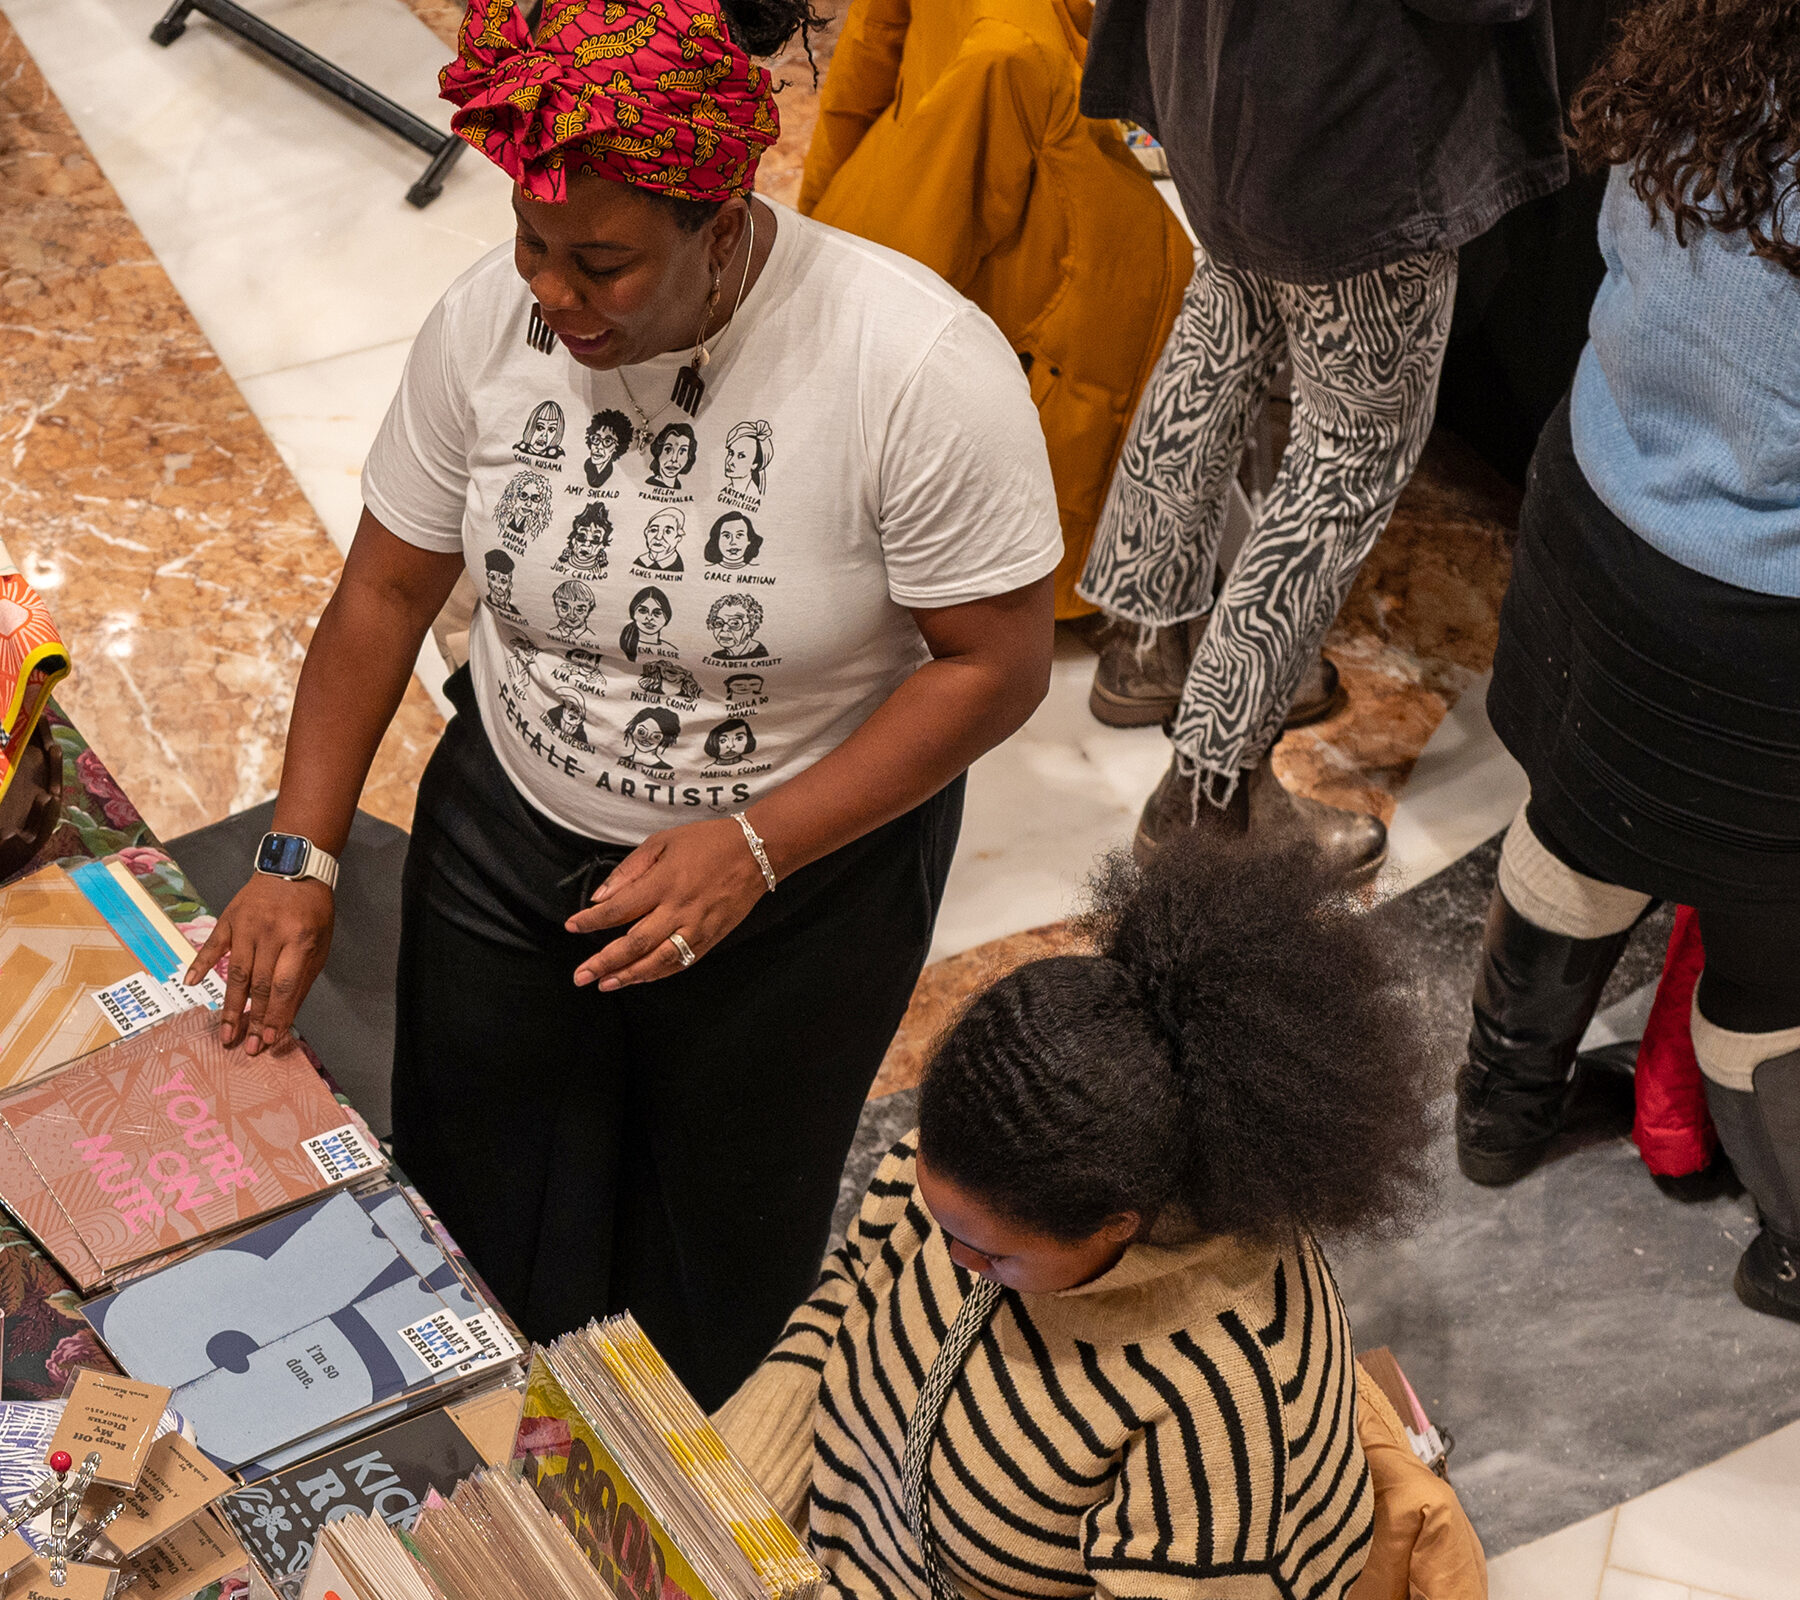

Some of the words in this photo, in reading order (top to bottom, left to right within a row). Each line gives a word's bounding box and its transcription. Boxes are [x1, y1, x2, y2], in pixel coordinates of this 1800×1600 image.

[534, 459, 563, 472] KUSAMA
[564, 484, 584, 496] AMY
[587, 487, 620, 500] SHERALD
[652, 487, 675, 496] HELEN
[502, 540, 525, 558] KRUGER
[550, 562, 568, 575] JUDY
[572, 569, 609, 580] CHICAGO
[629, 568, 652, 579] AGNES
[654, 572, 684, 582] MARTIN
[704, 571, 731, 583] GRACE
[737, 573, 777, 585] HARTIGAN
[637, 647, 654, 656] EVA
[702, 656, 748, 669] ELIZABETH
[551, 668, 570, 684] ALMA
[574, 679, 606, 698] THOMAS
[665, 697, 699, 712] CRONIN
[540, 712, 559, 737] LOUISE
[641, 766, 675, 781] WALKER
[595, 770, 751, 807] ARTISTS
[111, 986, 148, 1022] SALTY
[126, 979, 161, 1018] SARAH'S
[98, 991, 134, 1032] SERIES
[321, 1136, 358, 1173] SALTY
[337, 1129, 372, 1169] SARAH'S
[308, 1140, 343, 1181] SERIES
[71, 1134, 165, 1234] MUTE
[148, 1151, 213, 1211] ON
[417, 1321, 457, 1359] SALTY
[431, 1315, 471, 1357] SARAH'S
[466, 1319, 502, 1359] SARAH'S
[402, 1327, 443, 1369] SERIES
[286, 1358, 314, 1389] done.
[323, 1364, 339, 1379] so
[130, 1389, 149, 1398] Sarah
[85, 1406, 129, 1421] Manifesto
[88, 1416, 127, 1431] Uterus
[93, 1426, 114, 1437] My
[73, 1432, 93, 1442] Off
[96, 1436, 126, 1450] Keep
[168, 1445, 195, 1469] Matthews
[179, 1463, 187, 1472] by
[191, 1467, 209, 1482] Sarah
[134, 1488, 150, 1503] My
[126, 1496, 150, 1519] Keep
[212, 1545, 226, 1558] Sarah
[149, 1557, 162, 1574] My
[140, 1567, 161, 1590] Keep
